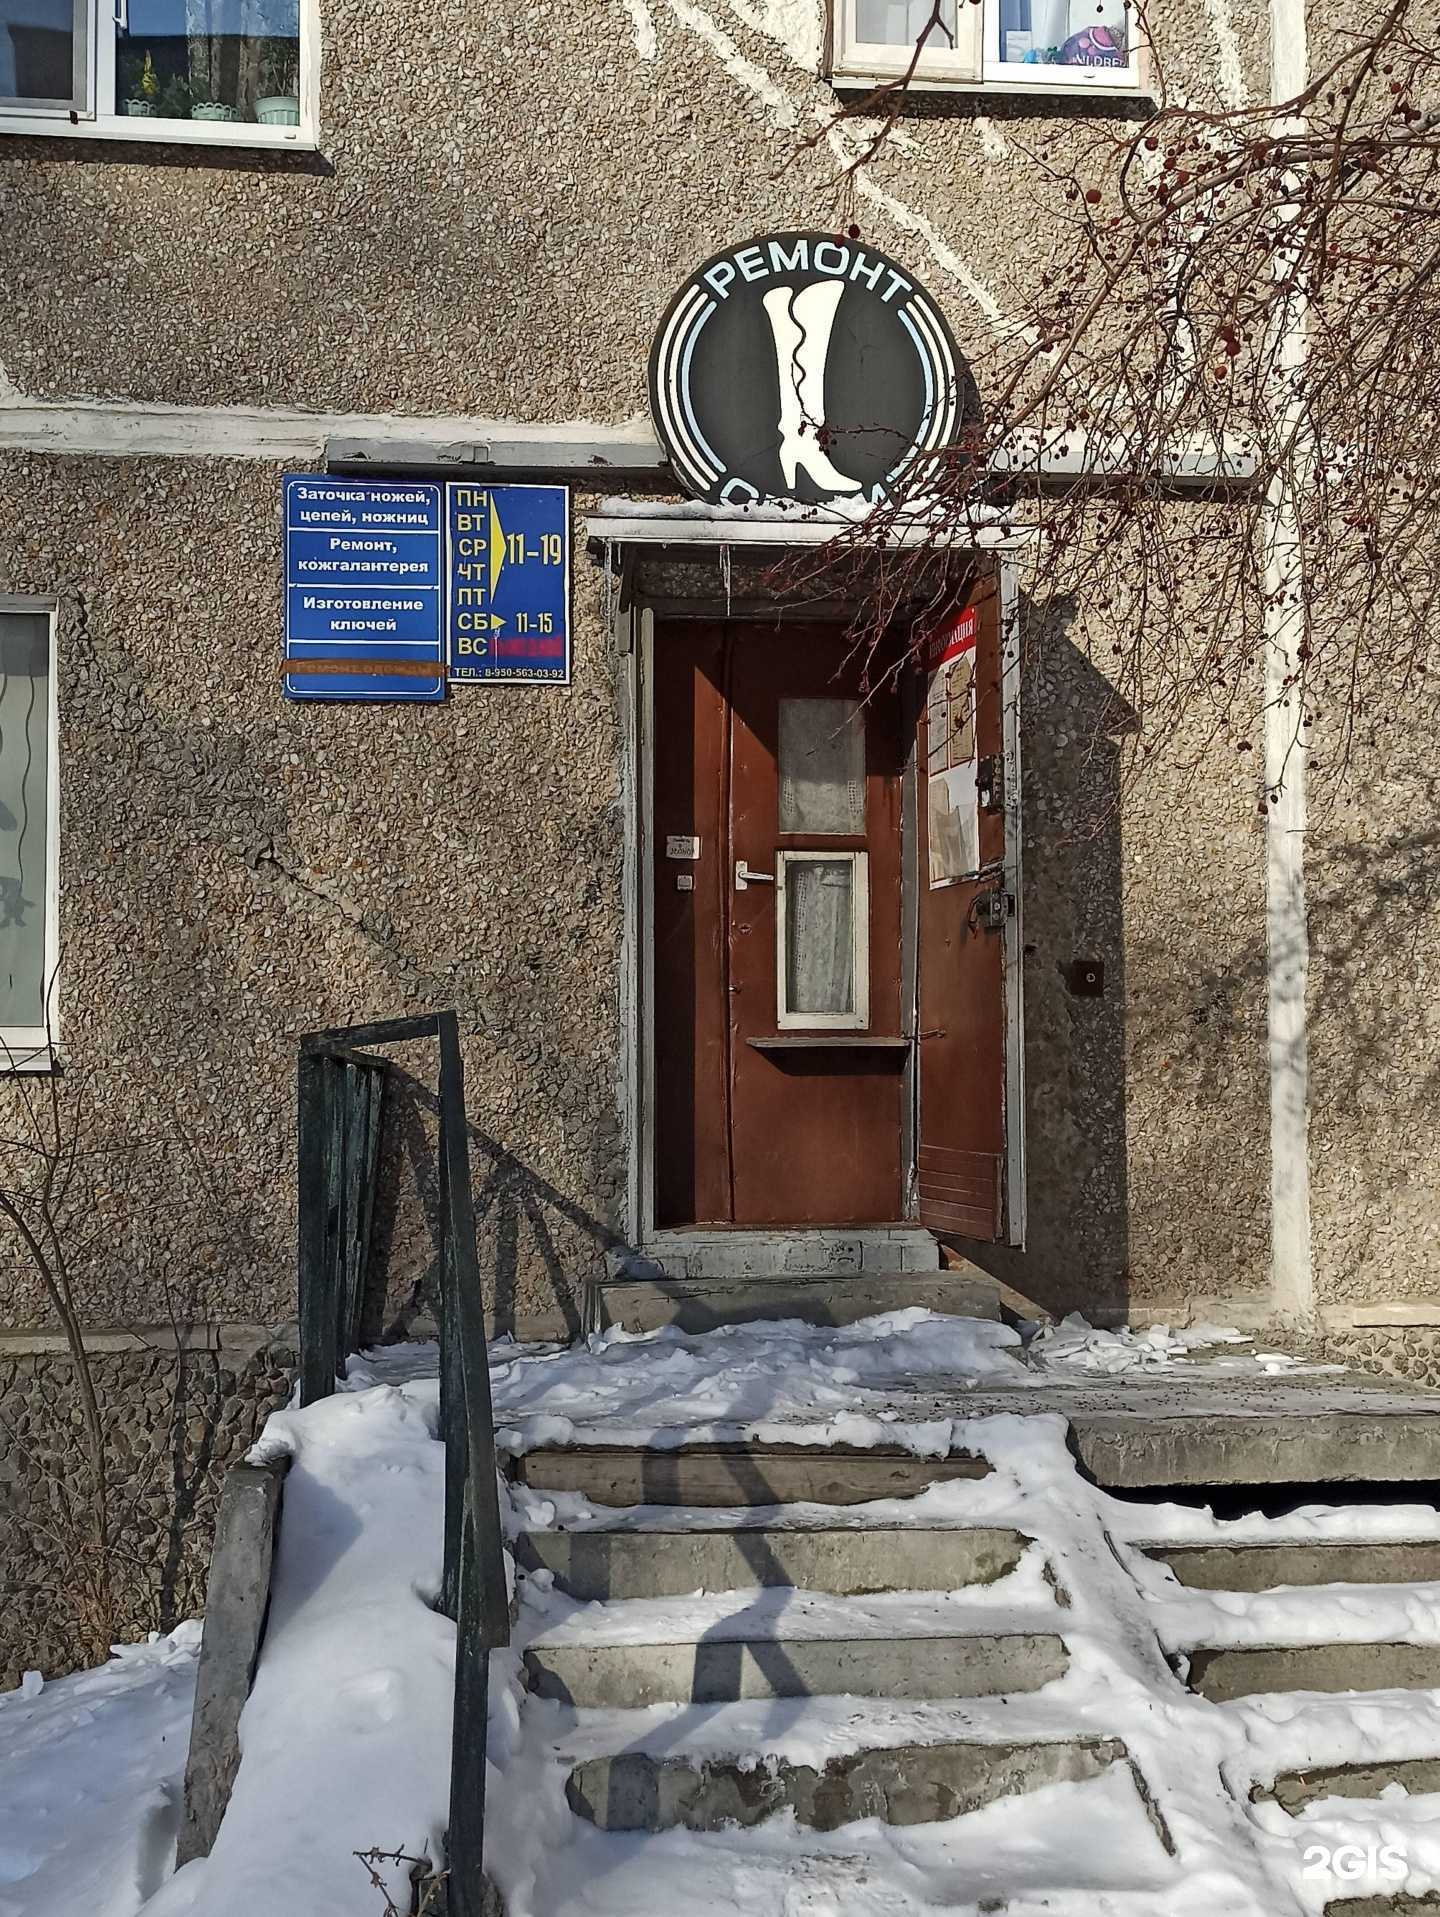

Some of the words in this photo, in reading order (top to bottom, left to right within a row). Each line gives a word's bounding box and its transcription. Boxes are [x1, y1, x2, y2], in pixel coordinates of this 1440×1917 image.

[703, 239, 913, 303] РЕМОНТ
[297, 487, 365, 501] Заточка
[370, 490, 431, 506] ножей,
[456, 489, 488, 507] ПН
[300, 509, 357, 525] цепей,
[362, 513, 429, 526] ножниц
[456, 513, 486, 532] ВТ
[330, 537, 398, 554] Ремонт,
[458, 538, 487, 557] СР
[506, 532, 562, 566] 11-19
[298, 559, 429, 575] кожгалантерея
[457, 562, 486, 581] ЧТ
[303, 596, 424, 611] Изготовление
[457, 587, 487, 606] ПТ
[330, 618, 397, 631] ключей
[457, 612, 489, 630] СБ
[515, 612, 553, 633] 11-15
[457, 637, 488, 655] ВС
